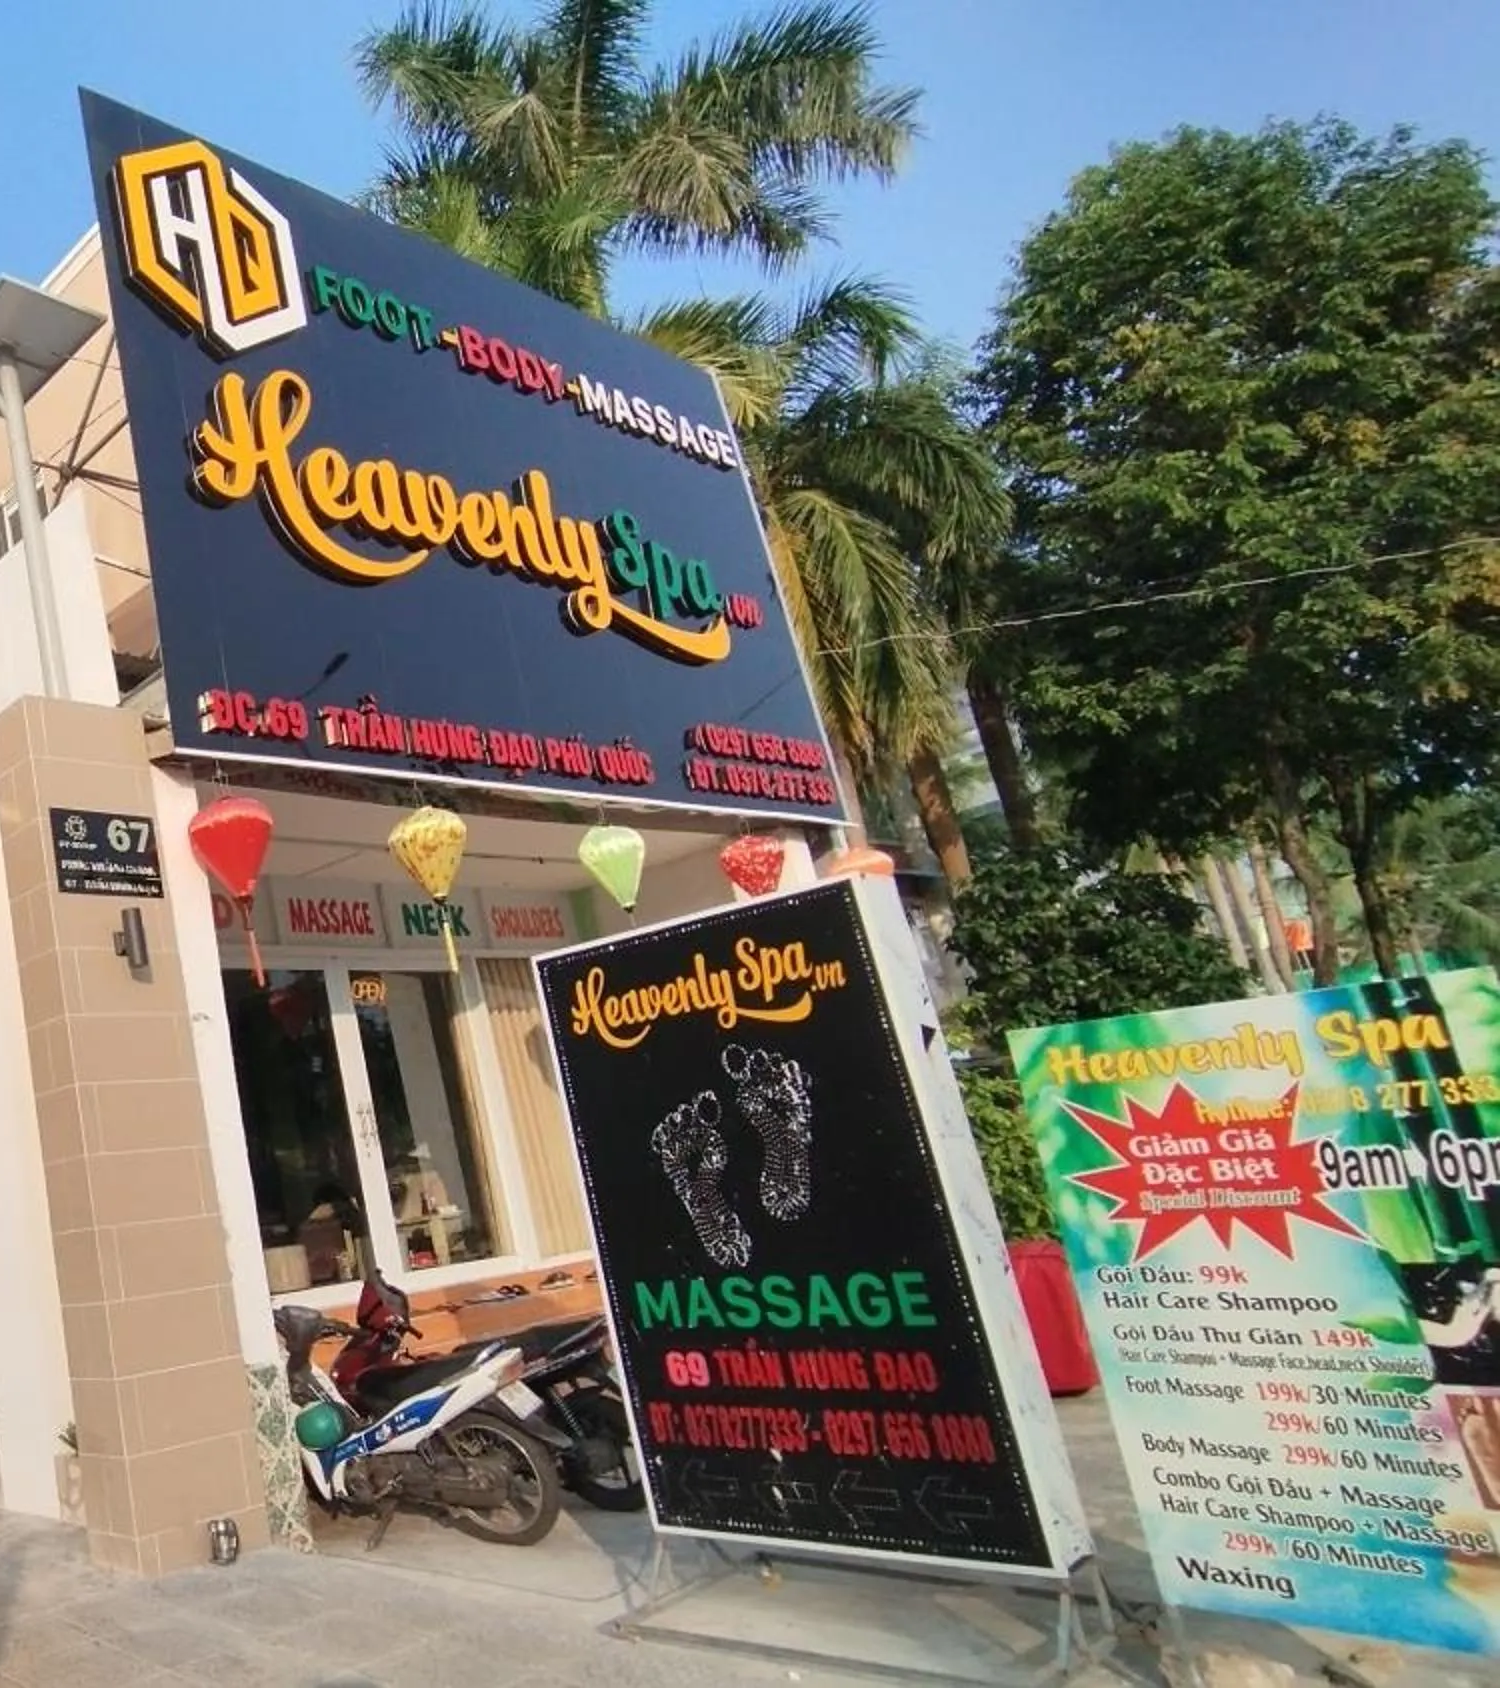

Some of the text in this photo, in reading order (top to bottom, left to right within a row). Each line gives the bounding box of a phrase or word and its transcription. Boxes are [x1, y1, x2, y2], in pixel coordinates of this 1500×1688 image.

[198, 369, 616, 634] Heavenly
[107, 819, 150, 853] 67
[288, 897, 376, 936] MASSAGE
[570, 953, 738, 1050] Heavenly
[1046, 1009, 1450, 1088] Heavenly Spa
[1216, 1126, 1277, 1154] Giá
[1316, 1131, 1500, 1199] 9am 6p
[1198, 1264, 1249, 1285] 99k
[634, 1270, 937, 1330] MASSAGE
[1102, 1290, 1339, 1316] Hair Care Shampoo
[1310, 1328, 1375, 1348] 149k
[665, 1350, 711, 1388] 69
[1125, 1375, 1163, 1395] Foot
[1165, 1378, 1246, 1401] Massage
[1345, 1386, 1433, 1412] Minutes
[1354, 1417, 1445, 1444] Minutes
[1141, 1432, 1185, 1459] Body
[1189, 1437, 1271, 1465] Massage
[1374, 1450, 1465, 1480] Minutes
[1152, 1467, 1222, 1492] Combo
[1339, 1483, 1447, 1517] Massage
[1158, 1493, 1200, 1515] Hair
[1204, 1497, 1251, 1521] Care
[1254, 1503, 1356, 1536] Shampoo
[1381, 1517, 1490, 1554] Massage
[1175, 1555, 1297, 1600] Waxing
[1325, 1542, 1426, 1576] Minutes
